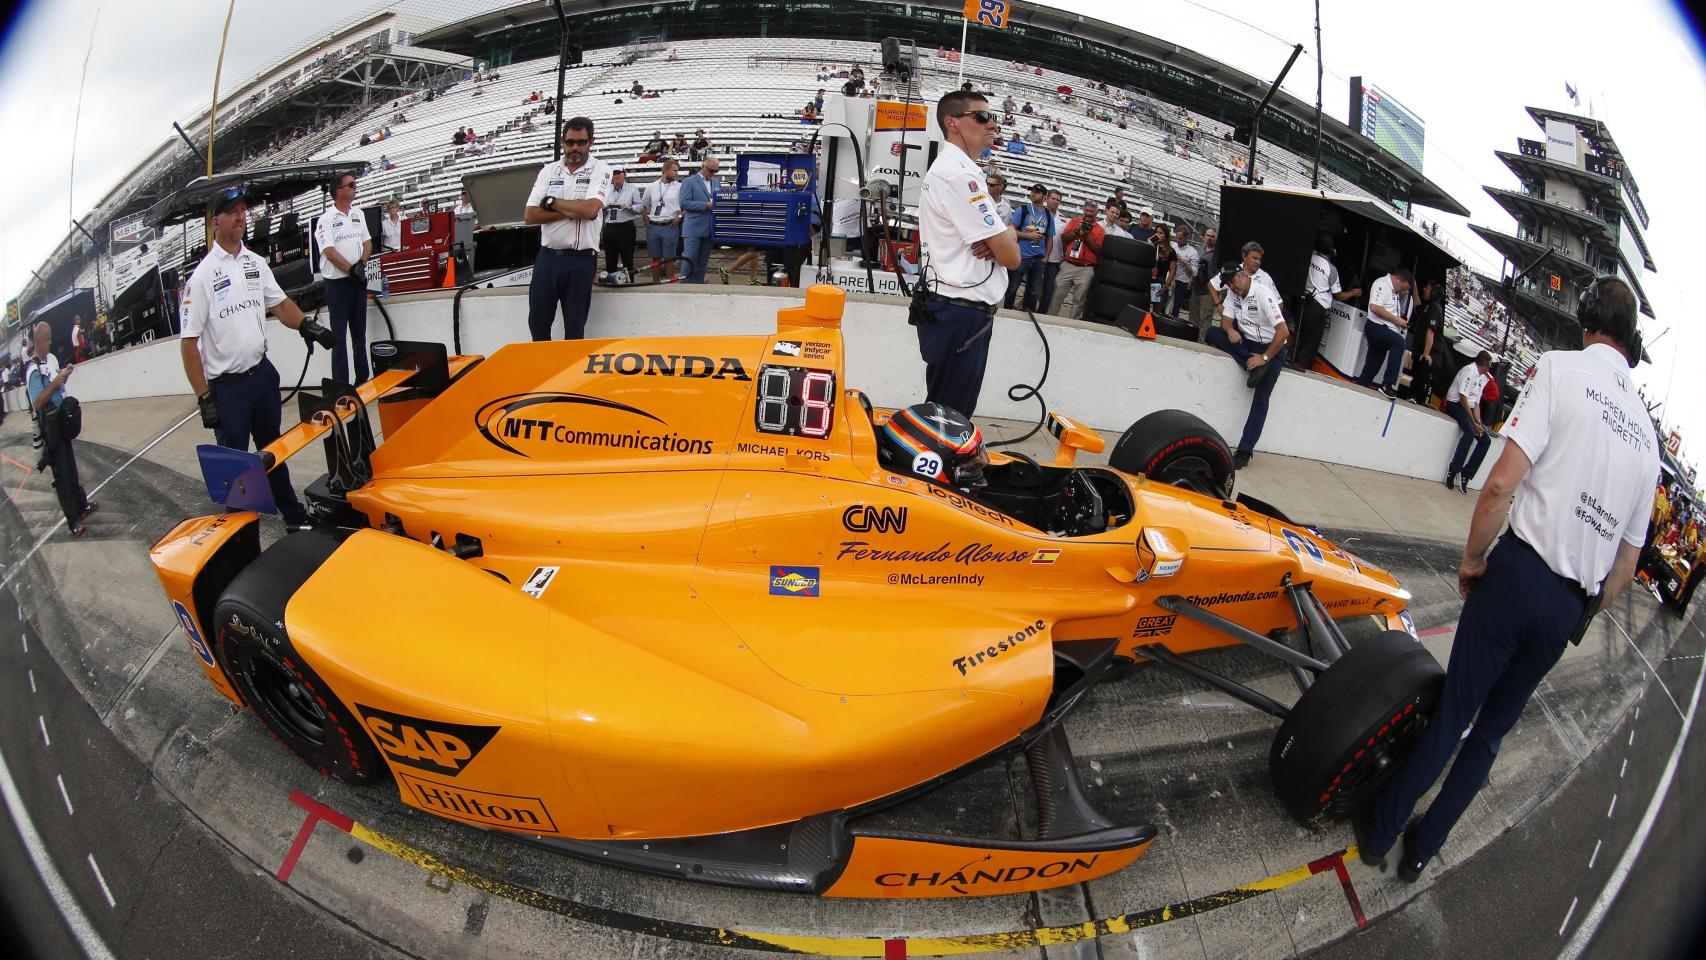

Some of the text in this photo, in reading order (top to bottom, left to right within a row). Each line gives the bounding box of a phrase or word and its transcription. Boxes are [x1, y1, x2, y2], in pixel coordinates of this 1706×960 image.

[978, 0, 1005, 28] 29
[886, 114, 917, 122] ANDRTTI
[1547, 135, 1575, 147] Panasonic
[879, 279, 914, 292] HOND
[804, 346, 832, 354] indycar
[584, 353, 752, 381] HONDA
[1586, 387, 1625, 424] McLAREN
[503, 417, 713, 455] NTT Communications
[737, 442, 830, 462] MICHAEL KORS
[916, 457, 939, 476] 29
[927, 483, 1015, 526] logitech
[842, 504, 908, 534] CNN
[836, 541, 1032, 566] Fernando Alonso
[773, 578, 815, 587] SUNOCO
[887, 573, 985, 586] @McLarenIndy
[1185, 589, 1279, 607] ShopHonda.com
[1139, 616, 1175, 628] GREAT
[952, 619, 1046, 676] Firestone
[366, 716, 472, 769] SAP
[415, 783, 542, 825] Hilton
[874, 854, 1100, 890] CHANDON
